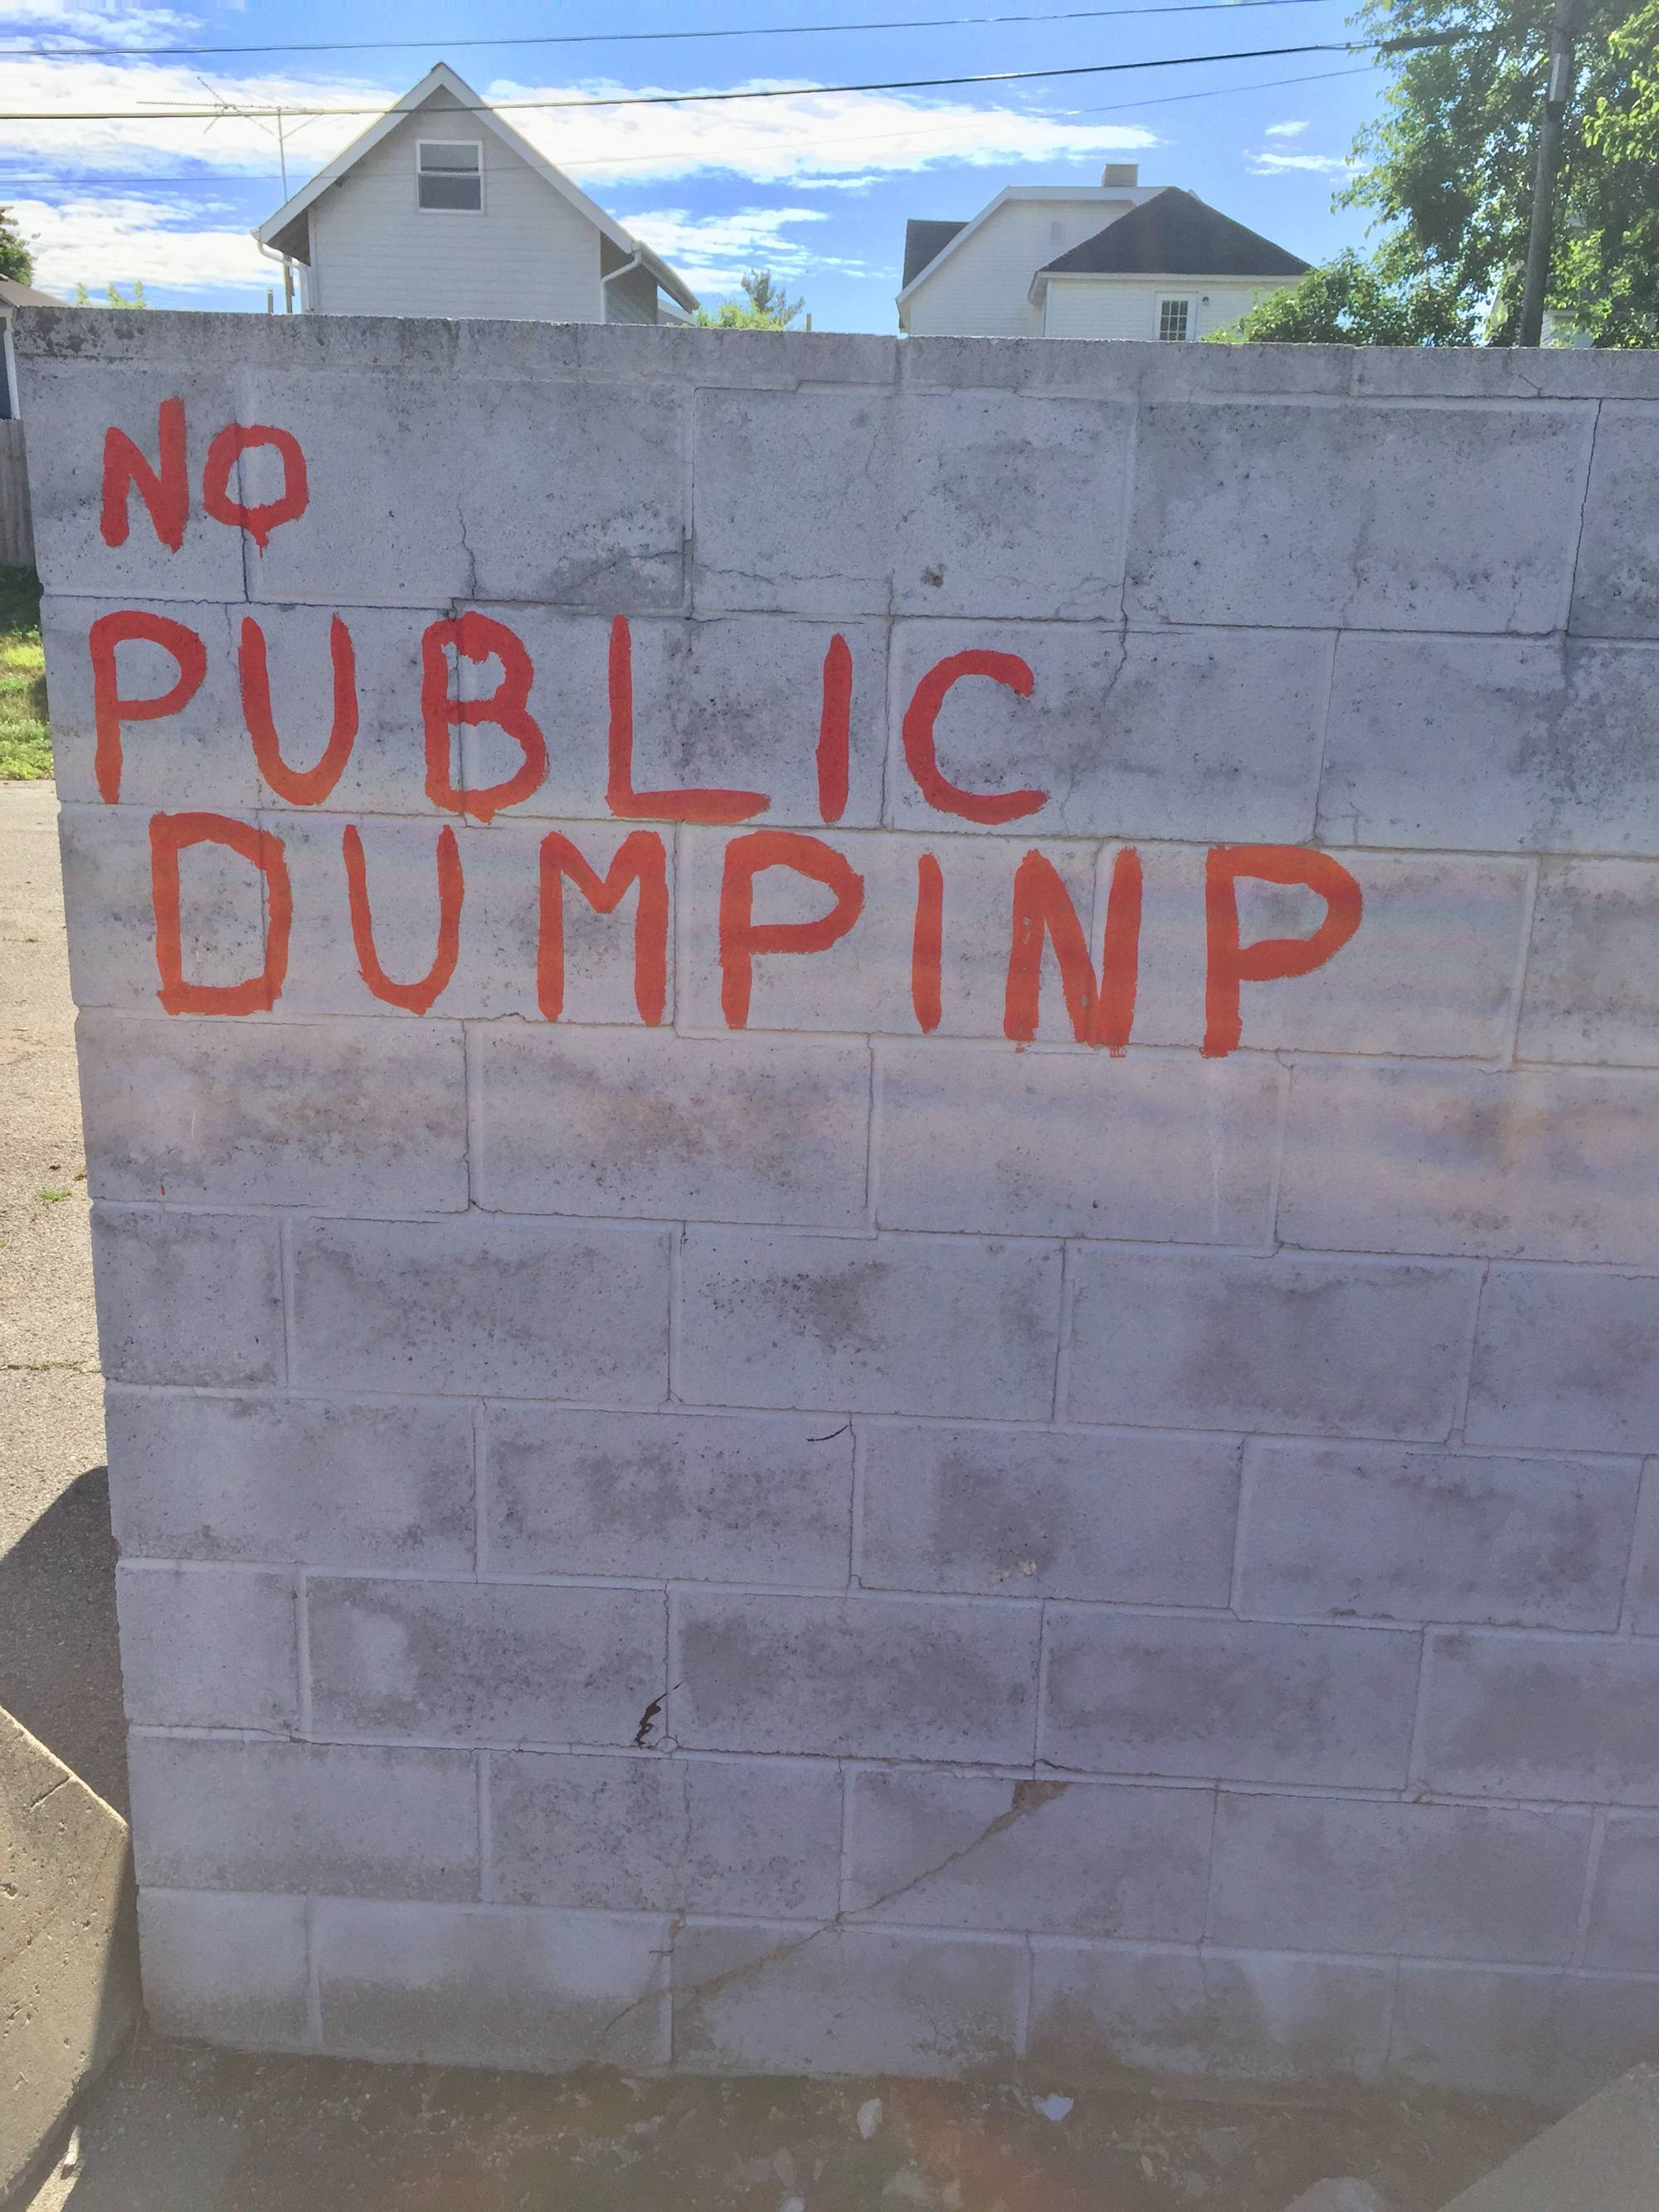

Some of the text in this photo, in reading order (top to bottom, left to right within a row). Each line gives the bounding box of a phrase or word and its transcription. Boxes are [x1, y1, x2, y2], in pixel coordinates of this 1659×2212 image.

[100, 397, 309, 556] NO
[89, 611, 1048, 825] PUBLIC
[149, 812, 1363, 1058] DUMPINP
